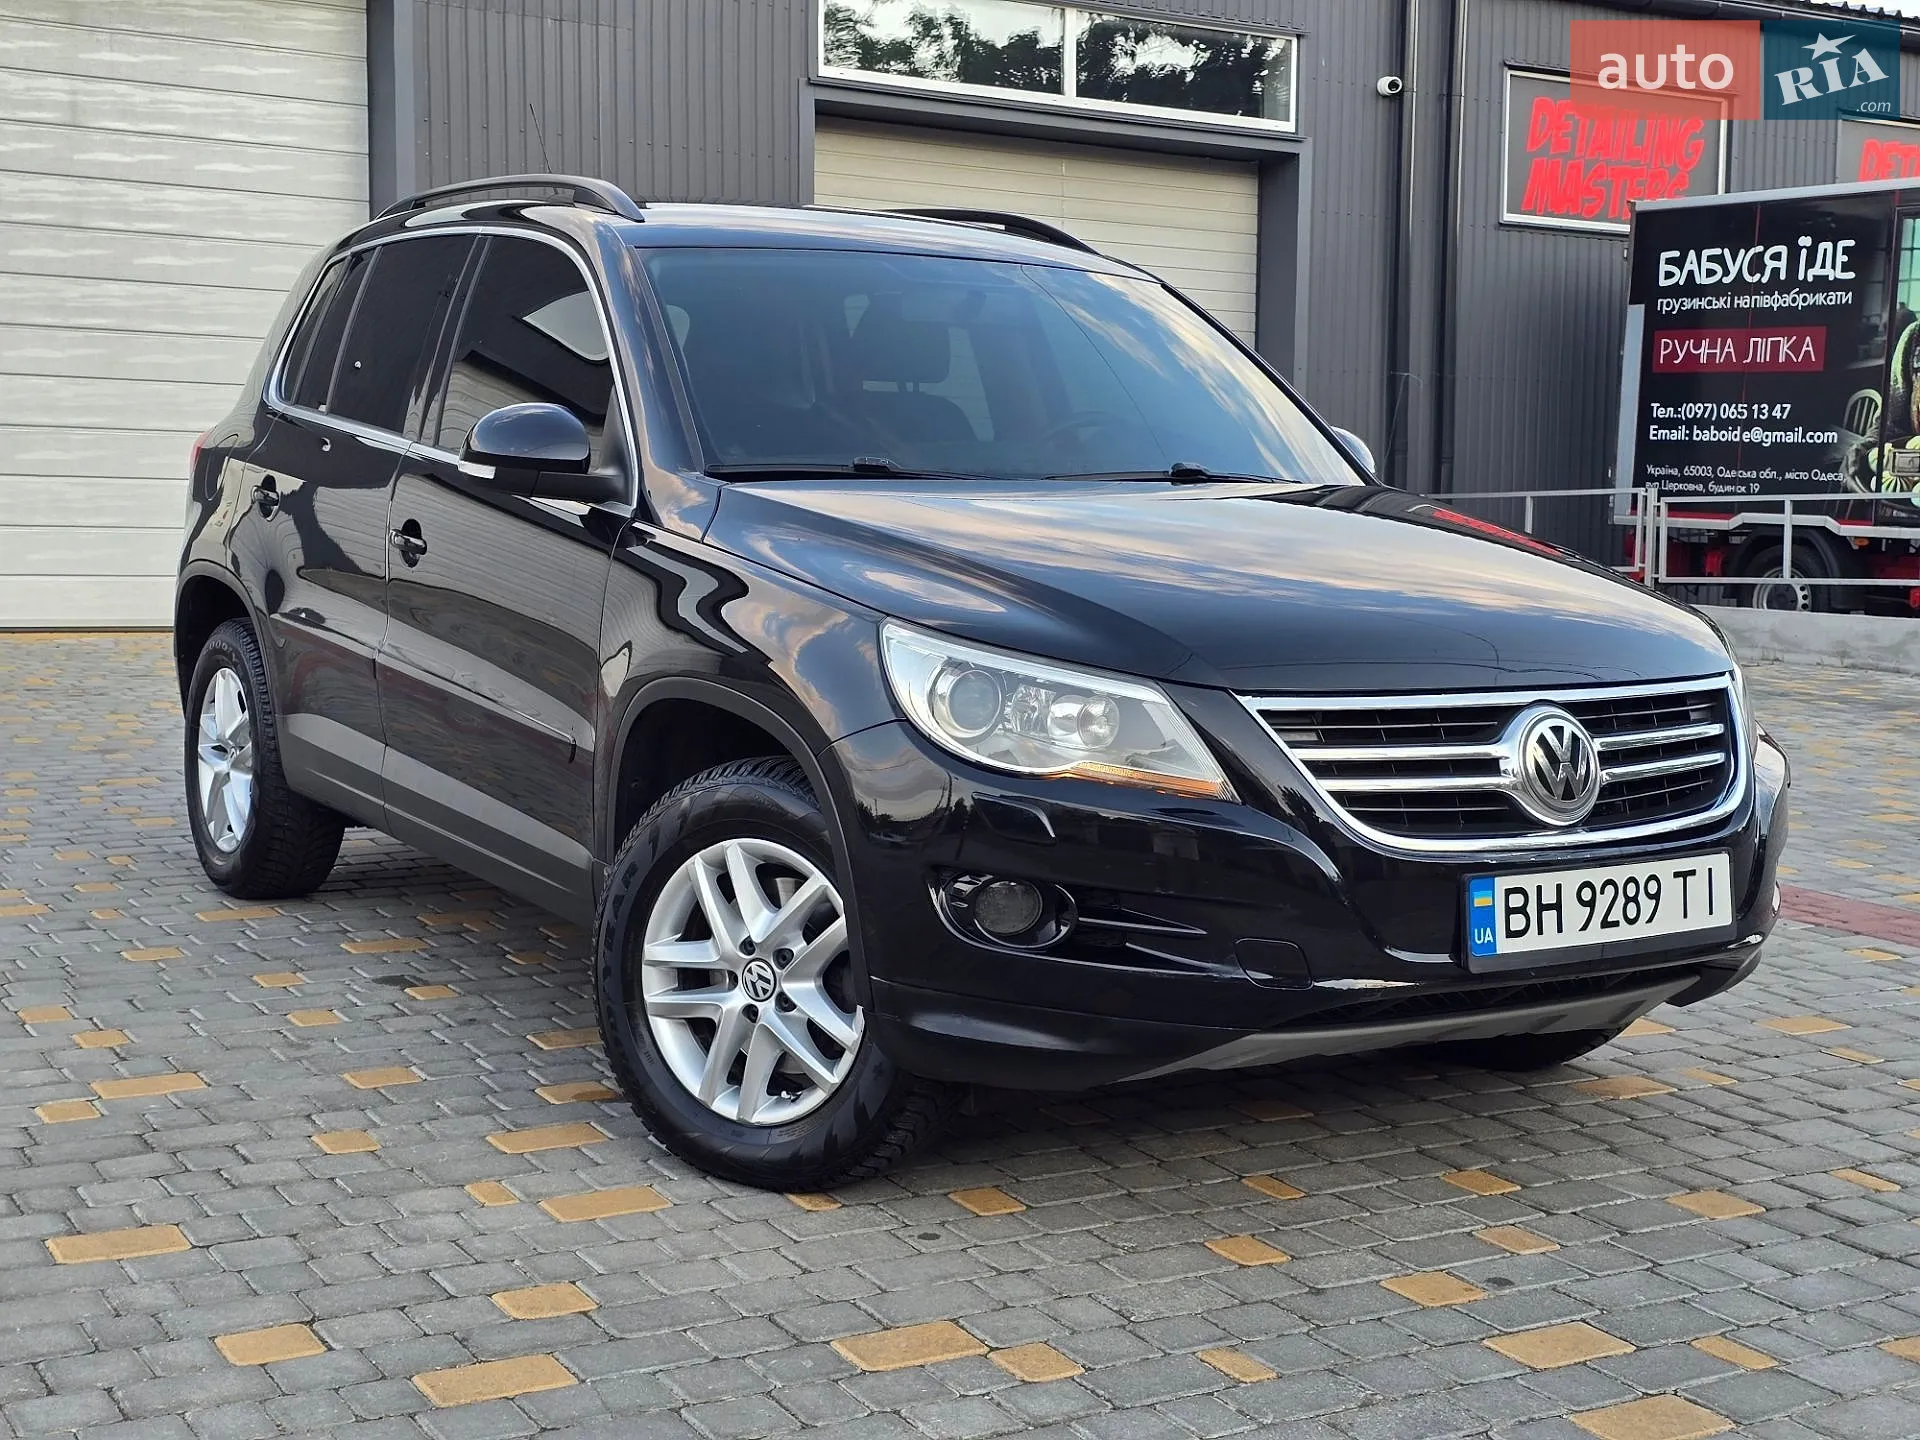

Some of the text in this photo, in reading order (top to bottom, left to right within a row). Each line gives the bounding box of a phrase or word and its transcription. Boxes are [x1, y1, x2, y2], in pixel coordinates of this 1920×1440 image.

[1526, 97, 1705, 171] DETAILING
[1856, 137, 1920, 183] DET
[1657, 245, 1788, 288] БАБУСЯ
[1657, 288, 1853, 315] грузинські напівфабрикати
[1659, 335, 1816, 365] РУЧНА ЛІПКА
[1719, 403, 1748, 420] 065
[1751, 403, 1770, 420] 13
[1771, 403, 1792, 420] 47
[1649, 425, 1838, 447] Email: baboide@gmail.com
[1646, 464, 1682, 479] Україна,
[1683, 465, 1714, 479] 65003,
[1716, 466, 1757, 479] Одеська
[1784, 469, 1809, 480] місто
[1708, 481, 1747, 495] будинок
[1749, 483, 1760, 494] 19
[1504, 882, 1564, 939] BH
[1575, 873, 1662, 932] 9289
[1474, 929, 1494, 945] UA
